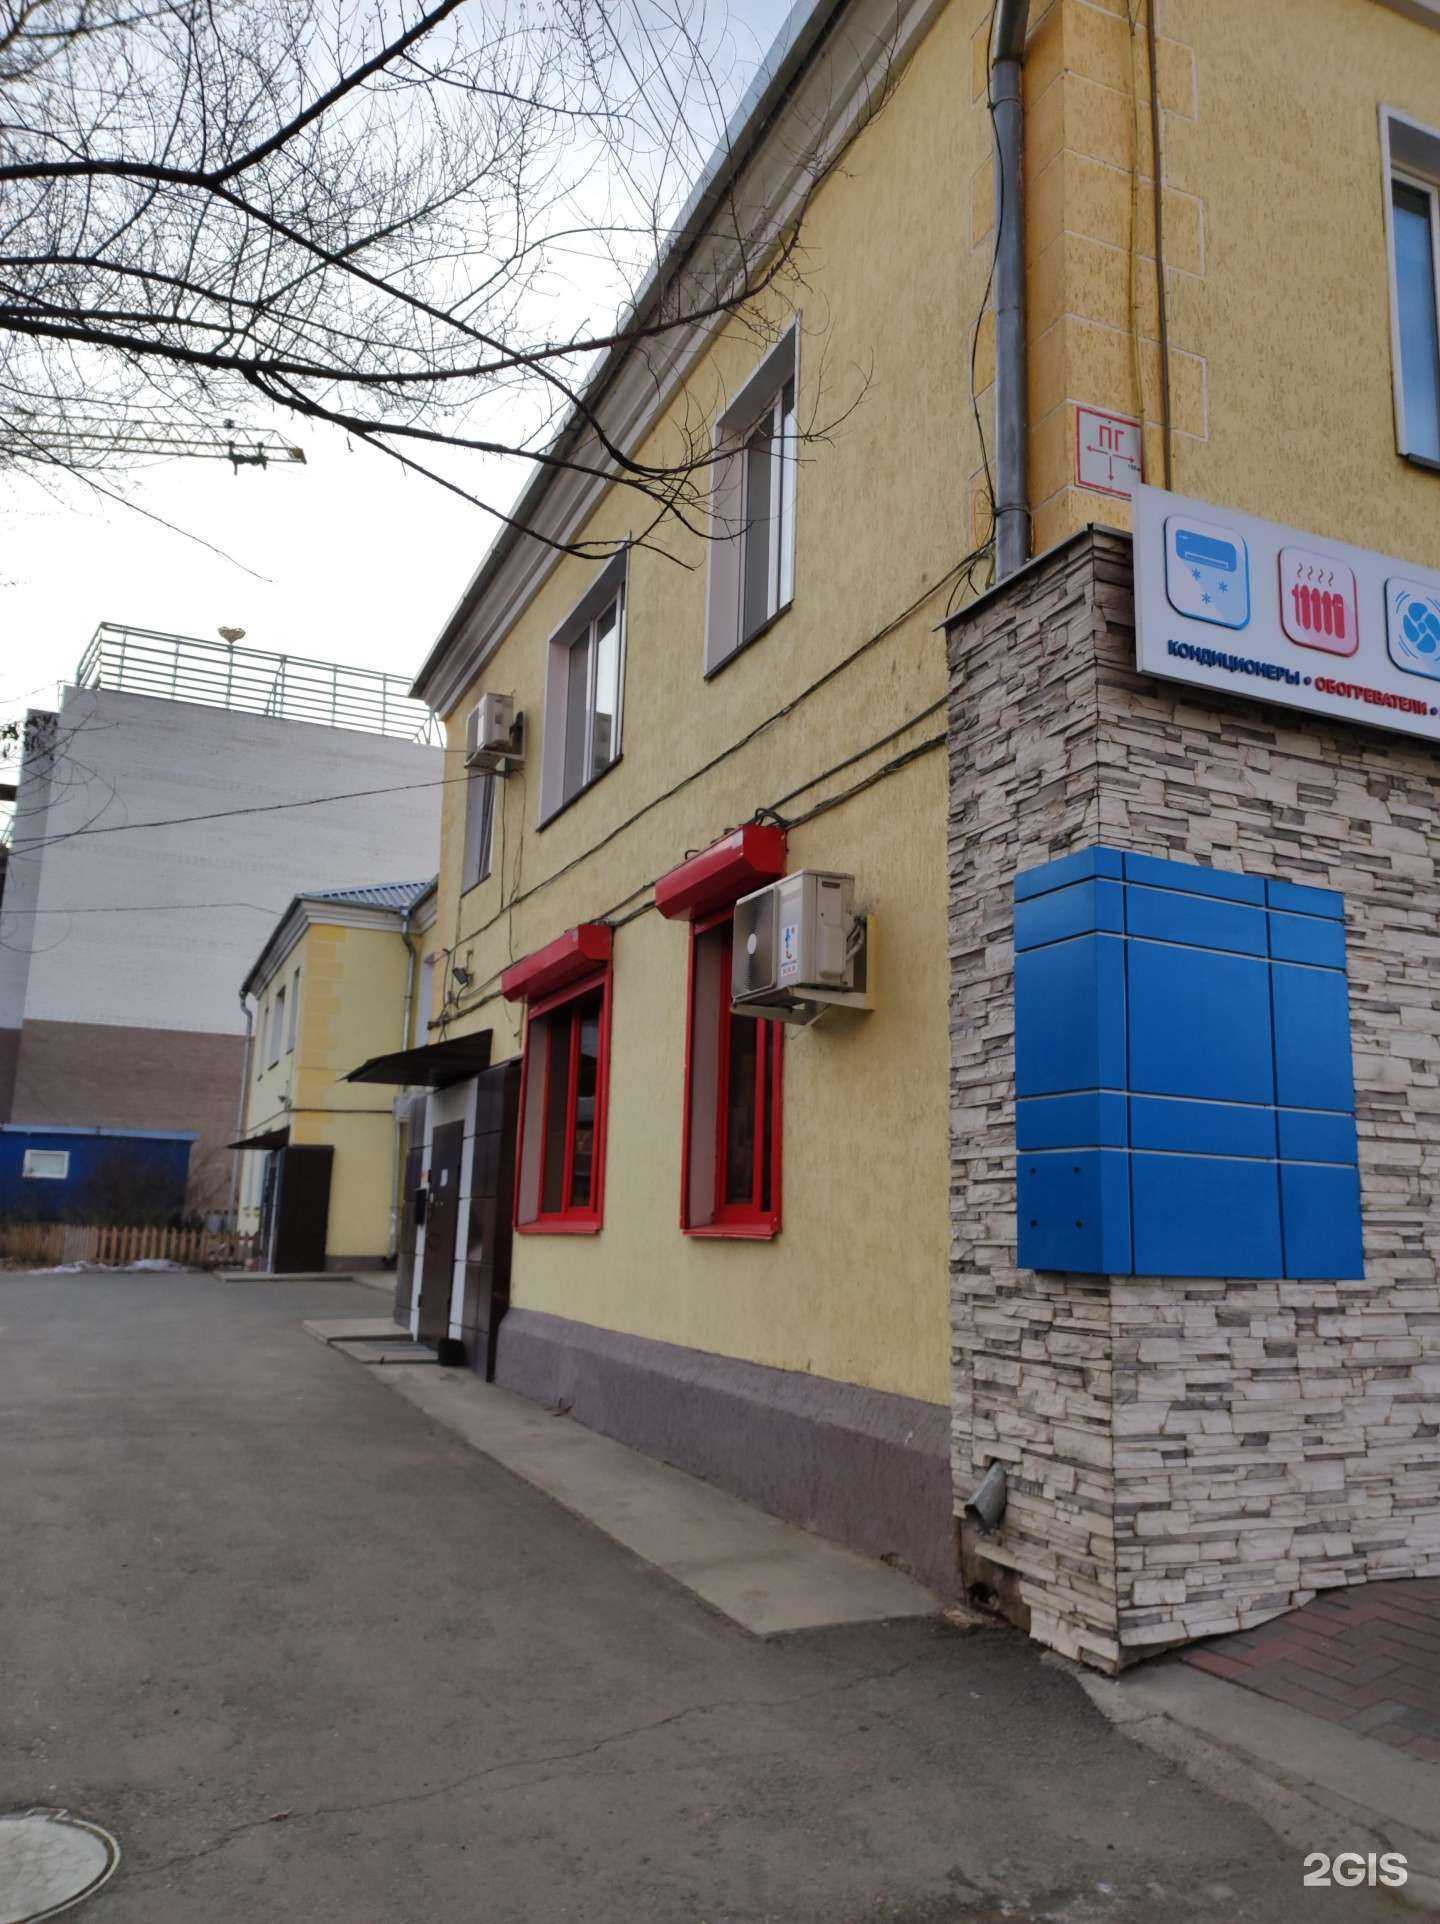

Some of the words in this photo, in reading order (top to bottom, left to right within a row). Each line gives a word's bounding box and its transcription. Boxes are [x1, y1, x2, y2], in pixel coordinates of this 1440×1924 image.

[1100, 424, 1125, 452] ПГ
[1168, 639, 1300, 686] КОНДИЦИОНЕРЫ
[1315, 676, 1428, 716] ОБОГРЕВАТЕЛИ
